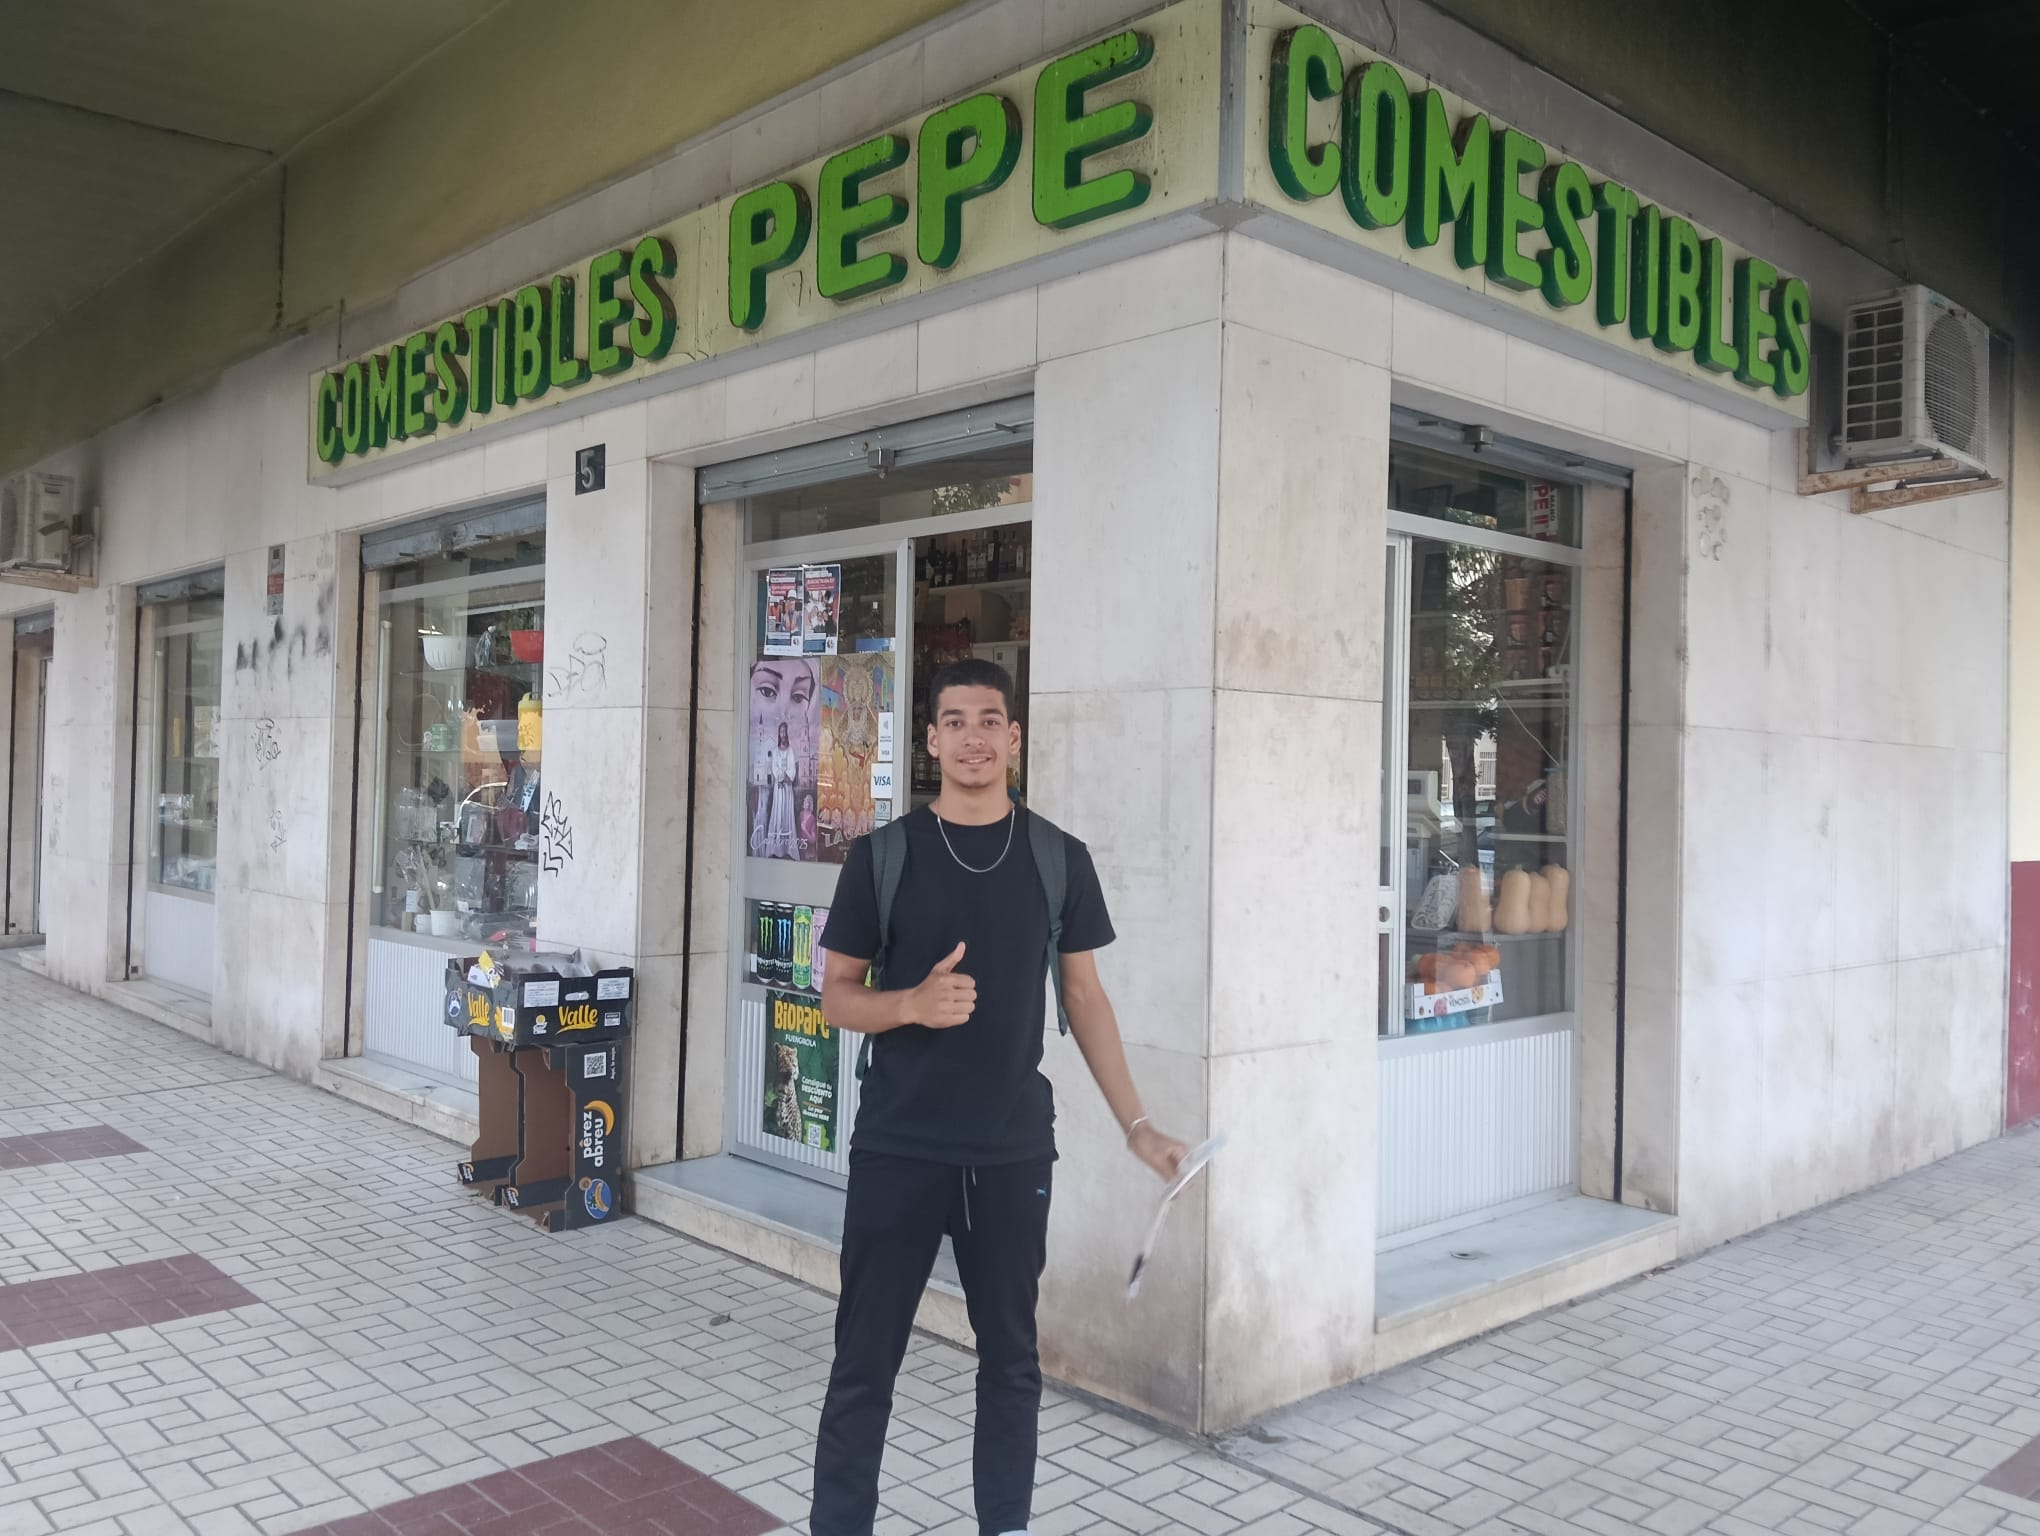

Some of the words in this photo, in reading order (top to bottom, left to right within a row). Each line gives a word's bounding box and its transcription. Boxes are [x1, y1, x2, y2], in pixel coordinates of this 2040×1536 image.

[1269, 24, 1810, 396] COMESTIBLES
[317, 236, 677, 463] COMESTIBLES
[728, 29, 1154, 330] PEPE
[579, 449, 595, 488] 5
[873, 775, 891, 786] VISA
[467, 991, 490, 1019] Valle
[558, 1004, 598, 1026] Valle
[801, 1085, 832, 1099] DESCUENTO
[594, 1118, 604, 1168] abreu
